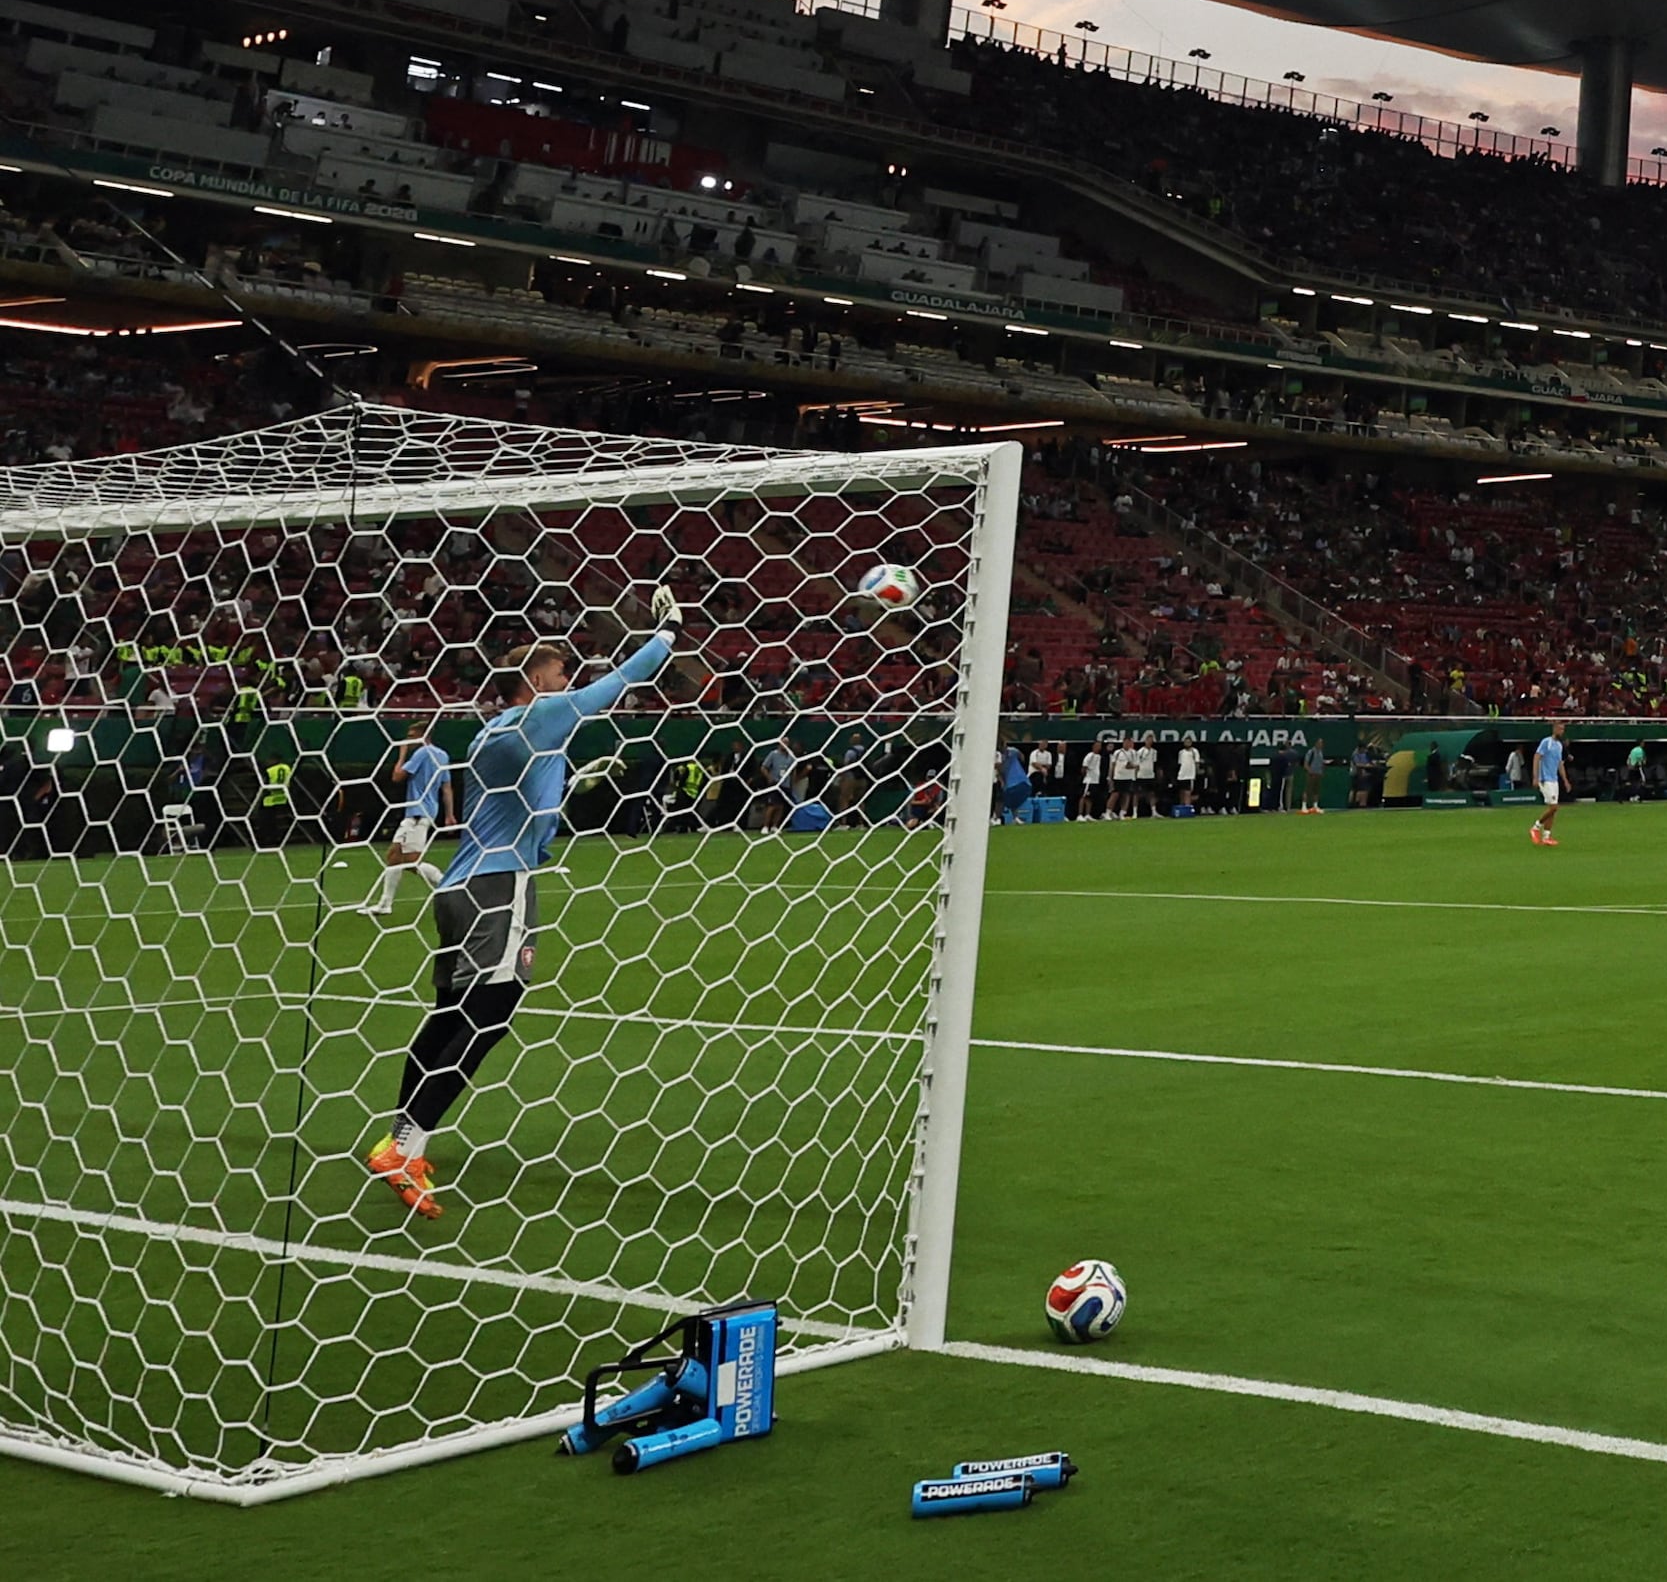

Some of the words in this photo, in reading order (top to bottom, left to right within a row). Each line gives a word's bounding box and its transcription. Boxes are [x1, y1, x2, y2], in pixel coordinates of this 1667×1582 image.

[150, 166, 196, 185] COPA
[200, 174, 275, 199] MUNDIAL
[278, 188, 297, 204] DE
[303, 192, 322, 207] LA
[327, 196, 360, 212] FIFA
[891, 290, 1026, 320] GUADALAJARA
[734, 1326, 757, 1437] POWERADE
[968, 1454, 1054, 1473] POWERADE
[927, 1477, 1016, 1498] POWERADE
